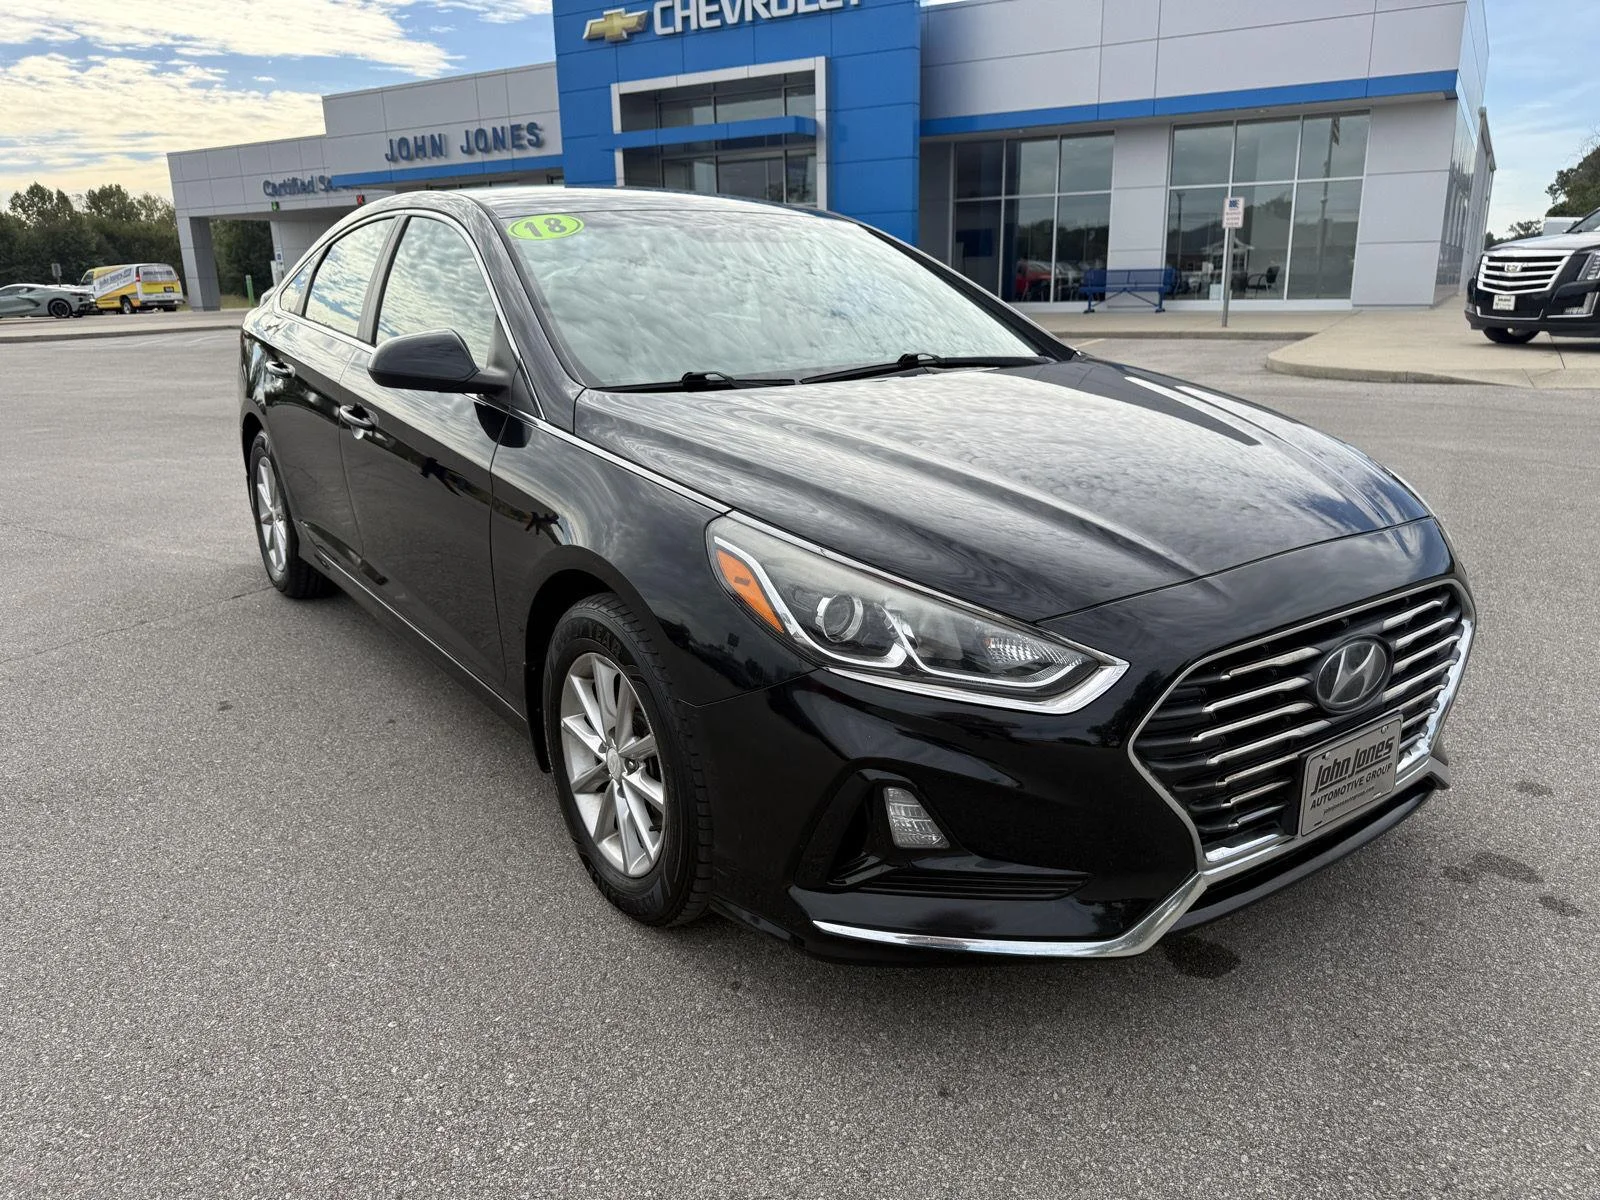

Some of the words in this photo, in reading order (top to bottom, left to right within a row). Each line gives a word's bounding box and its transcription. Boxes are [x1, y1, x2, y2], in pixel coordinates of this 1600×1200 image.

[654, 0, 859, 36] CHEVRO
[385, 133, 445, 162] JOHN
[460, 122, 543, 155] JONES
[524, 217, 567, 237] 18
[1310, 757, 1351, 796] John
[1347, 736, 1395, 778] Jones
[1310, 775, 1364, 810] AUTOMOTIVE
[1366, 762, 1392, 783] GROUP
